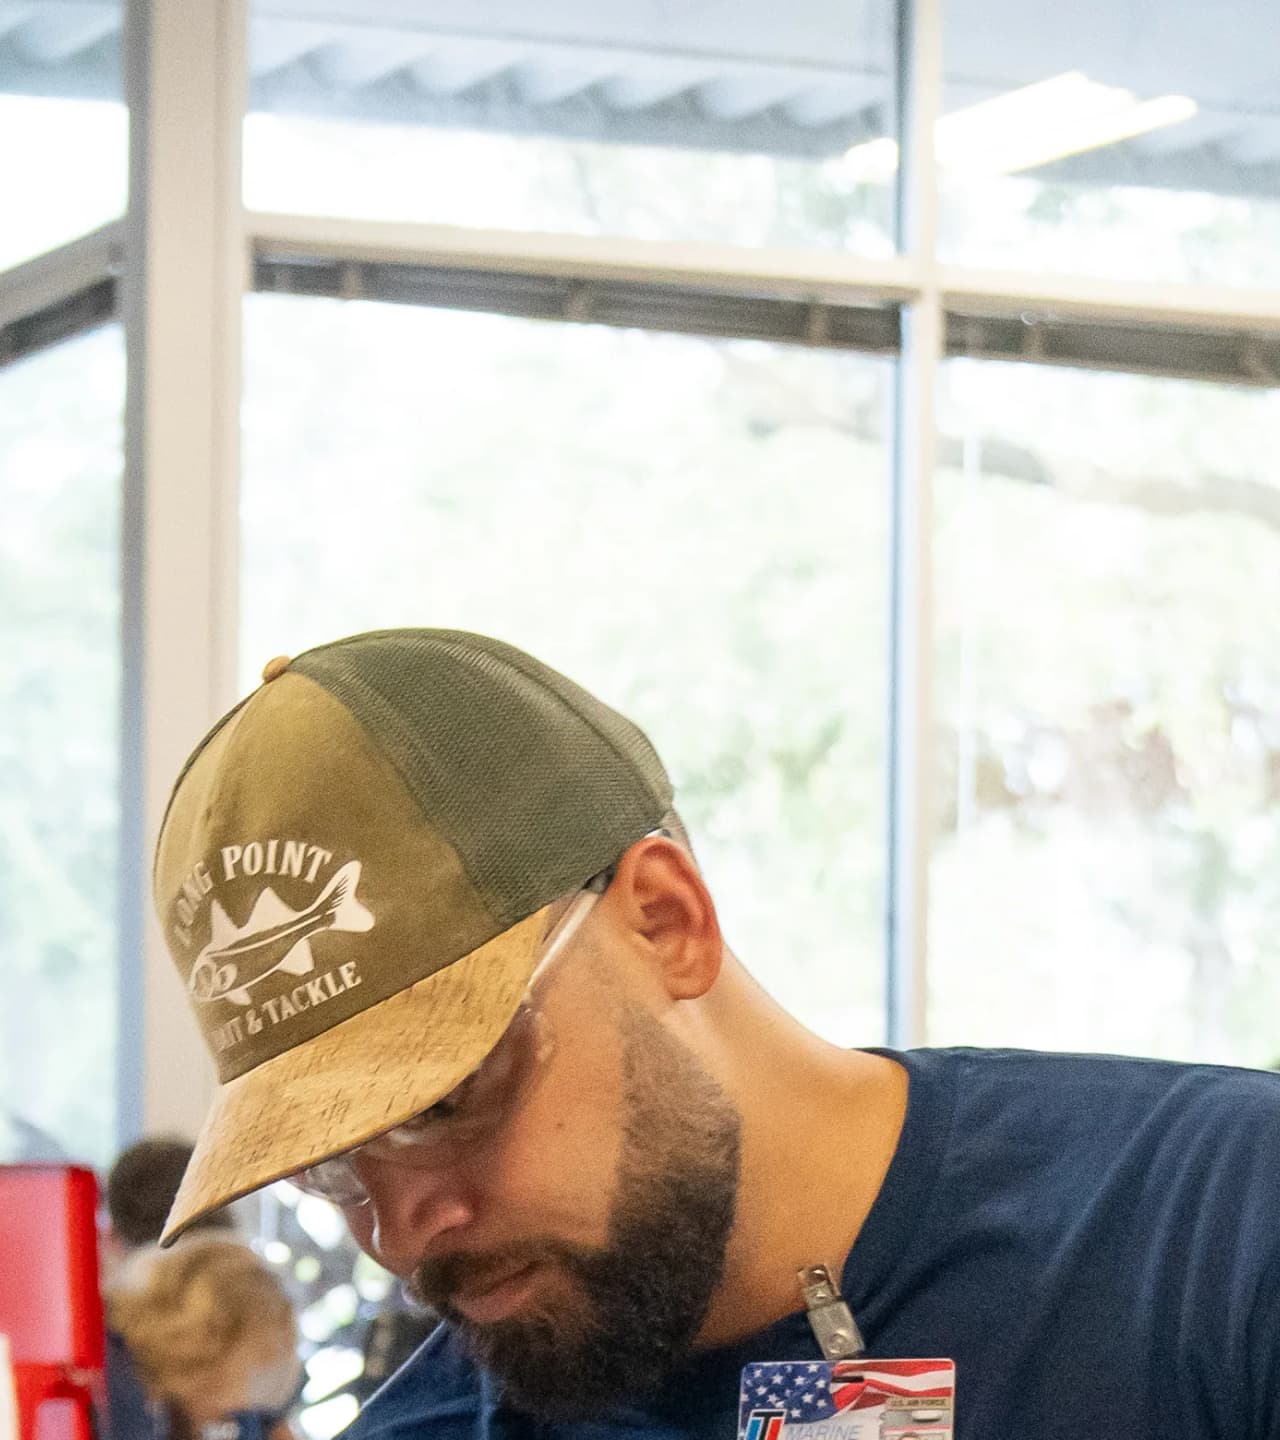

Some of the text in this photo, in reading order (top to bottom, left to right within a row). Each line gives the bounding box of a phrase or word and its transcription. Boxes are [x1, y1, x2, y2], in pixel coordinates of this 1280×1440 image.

[220, 839, 334, 883] POINT
[245, 1009, 264, 1035] &
[262, 960, 363, 1025] TACKLE
